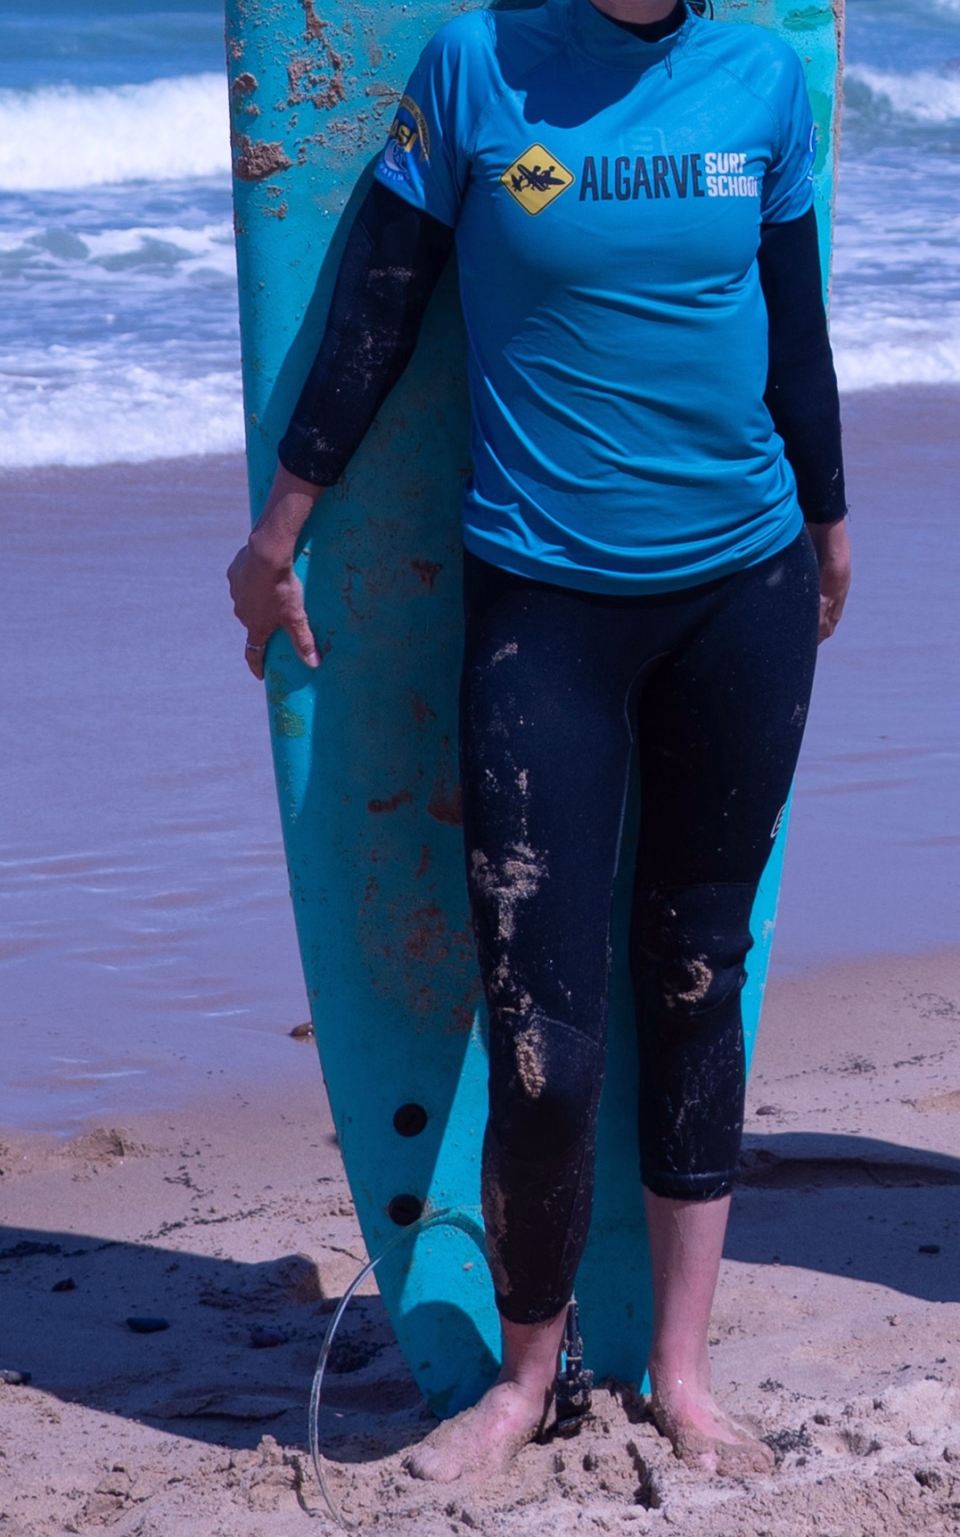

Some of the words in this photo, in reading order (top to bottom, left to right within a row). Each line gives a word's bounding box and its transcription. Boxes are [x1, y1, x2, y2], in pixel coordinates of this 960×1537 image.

[705, 152, 747, 174] SURF
[579, 153, 705, 202] ALGARVE
[706, 175, 758, 197] SCHOOL
